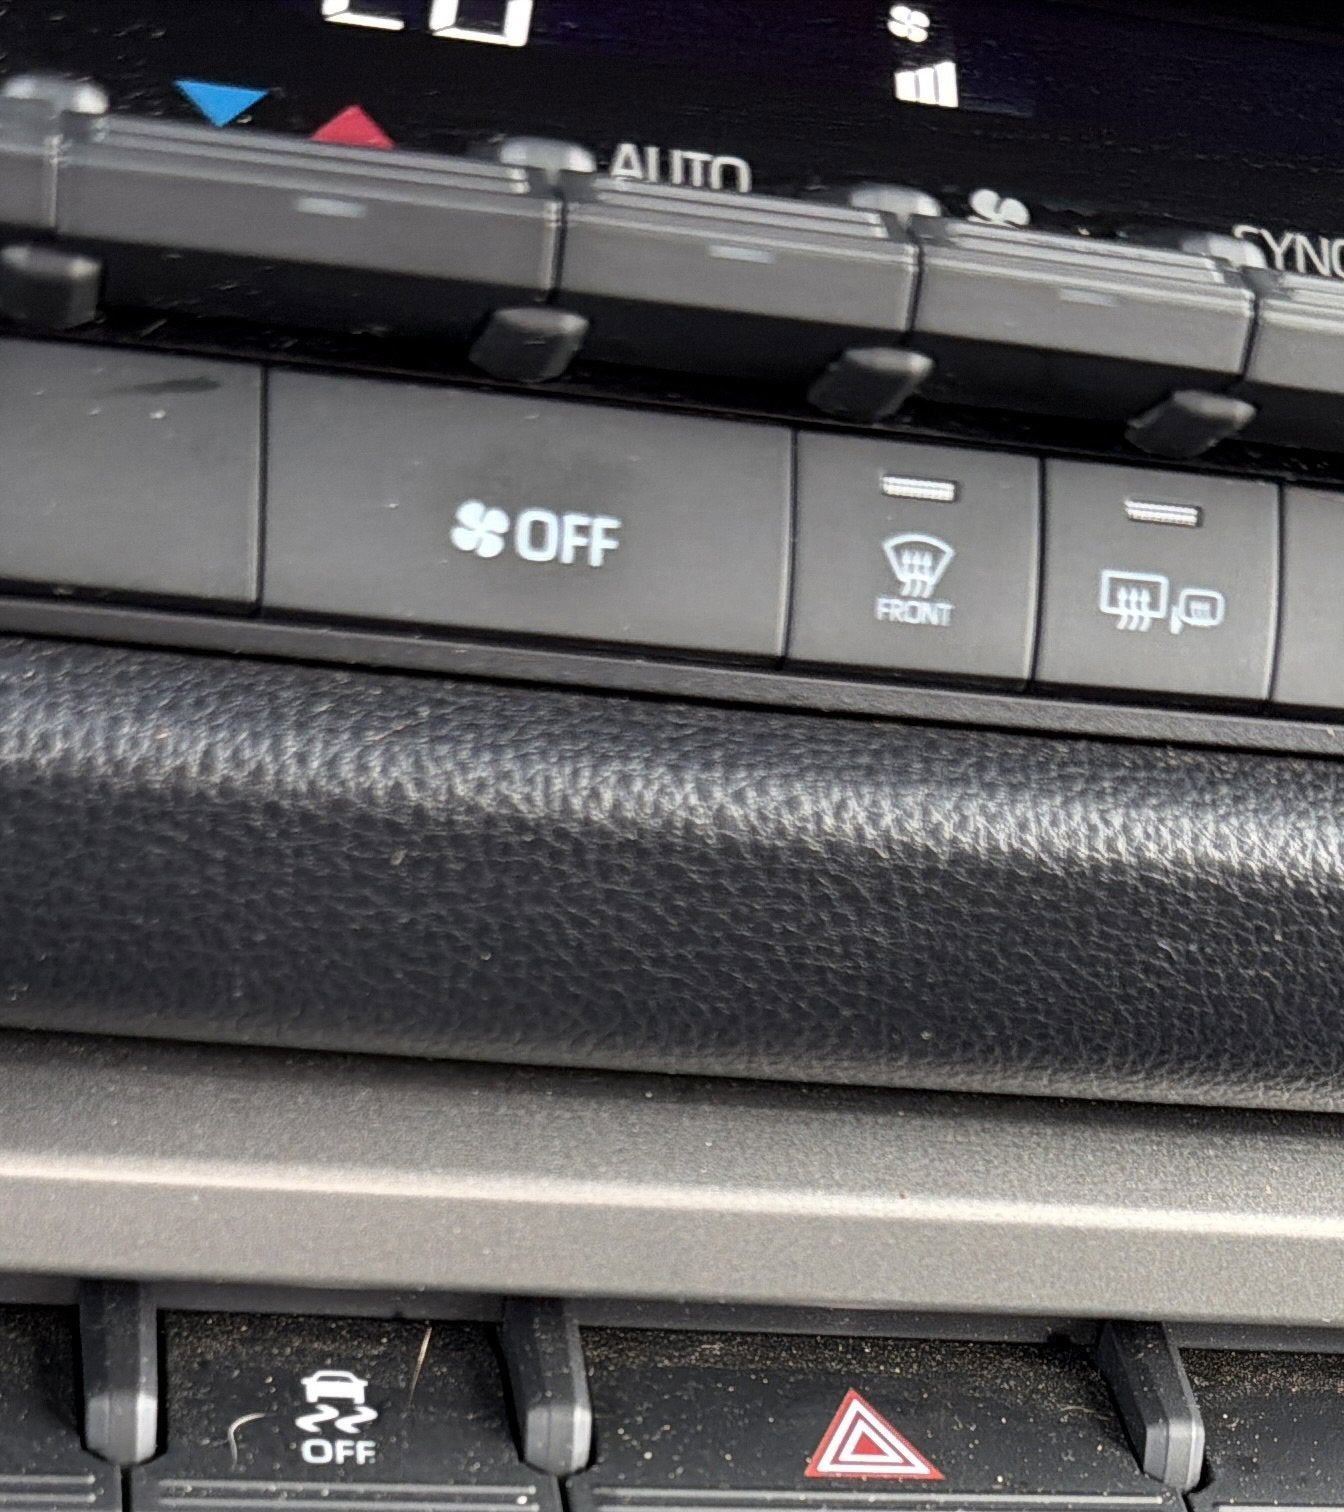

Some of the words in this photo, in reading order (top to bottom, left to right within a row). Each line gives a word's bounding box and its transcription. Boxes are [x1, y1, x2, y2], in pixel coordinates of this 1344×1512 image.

[514, 510, 621, 569] OFF
[875, 596, 953, 629] FRONT
[301, 1439, 376, 1465] OFF
